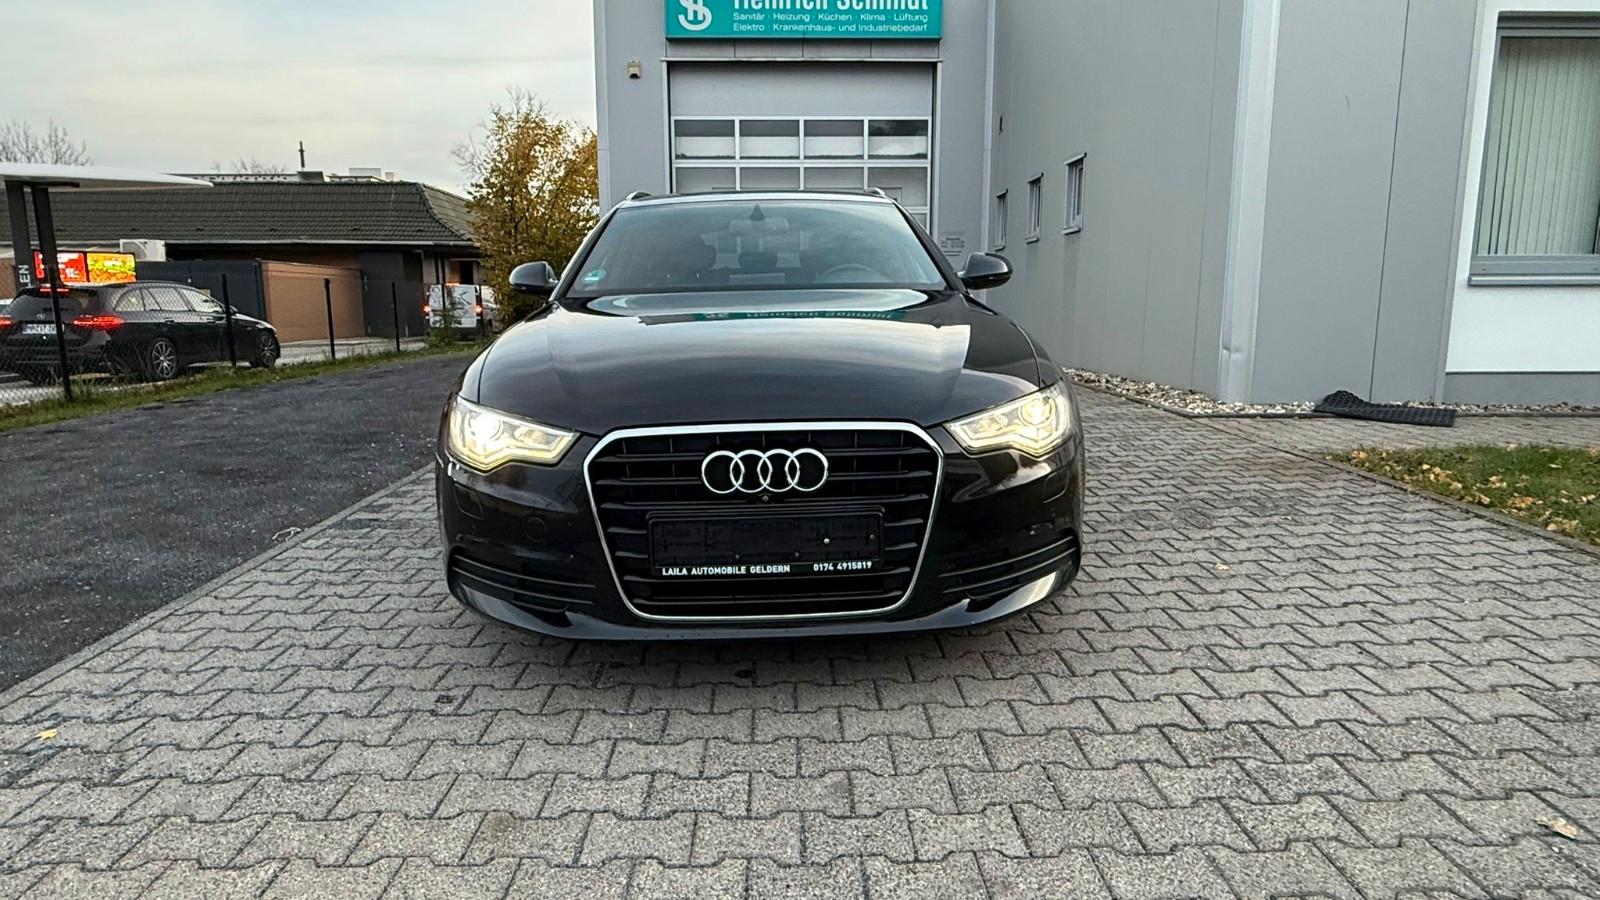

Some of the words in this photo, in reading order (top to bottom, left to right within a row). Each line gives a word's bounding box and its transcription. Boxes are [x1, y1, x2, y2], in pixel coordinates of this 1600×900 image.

[733, 12, 765, 21] Sanitär
[773, 12, 810, 22] Heizung
[818, 13, 852, 21] Küchen
[860, 13, 886, 21] Klima
[893, 13, 928, 23] Lüftung
[733, 23, 765, 31] Elektro
[773, 23, 836, 32] Krankenhaus-
[838, 24, 856, 32] und
[858, 23, 928, 32] Industriebedarf
[662, 567, 688, 576] LAILA
[691, 566, 747, 575] AUTOMOBILE
[750, 564, 791, 574] GELDERN
[813, 563, 834, 572] 0174
[837, 561, 872, 571] 4915819
